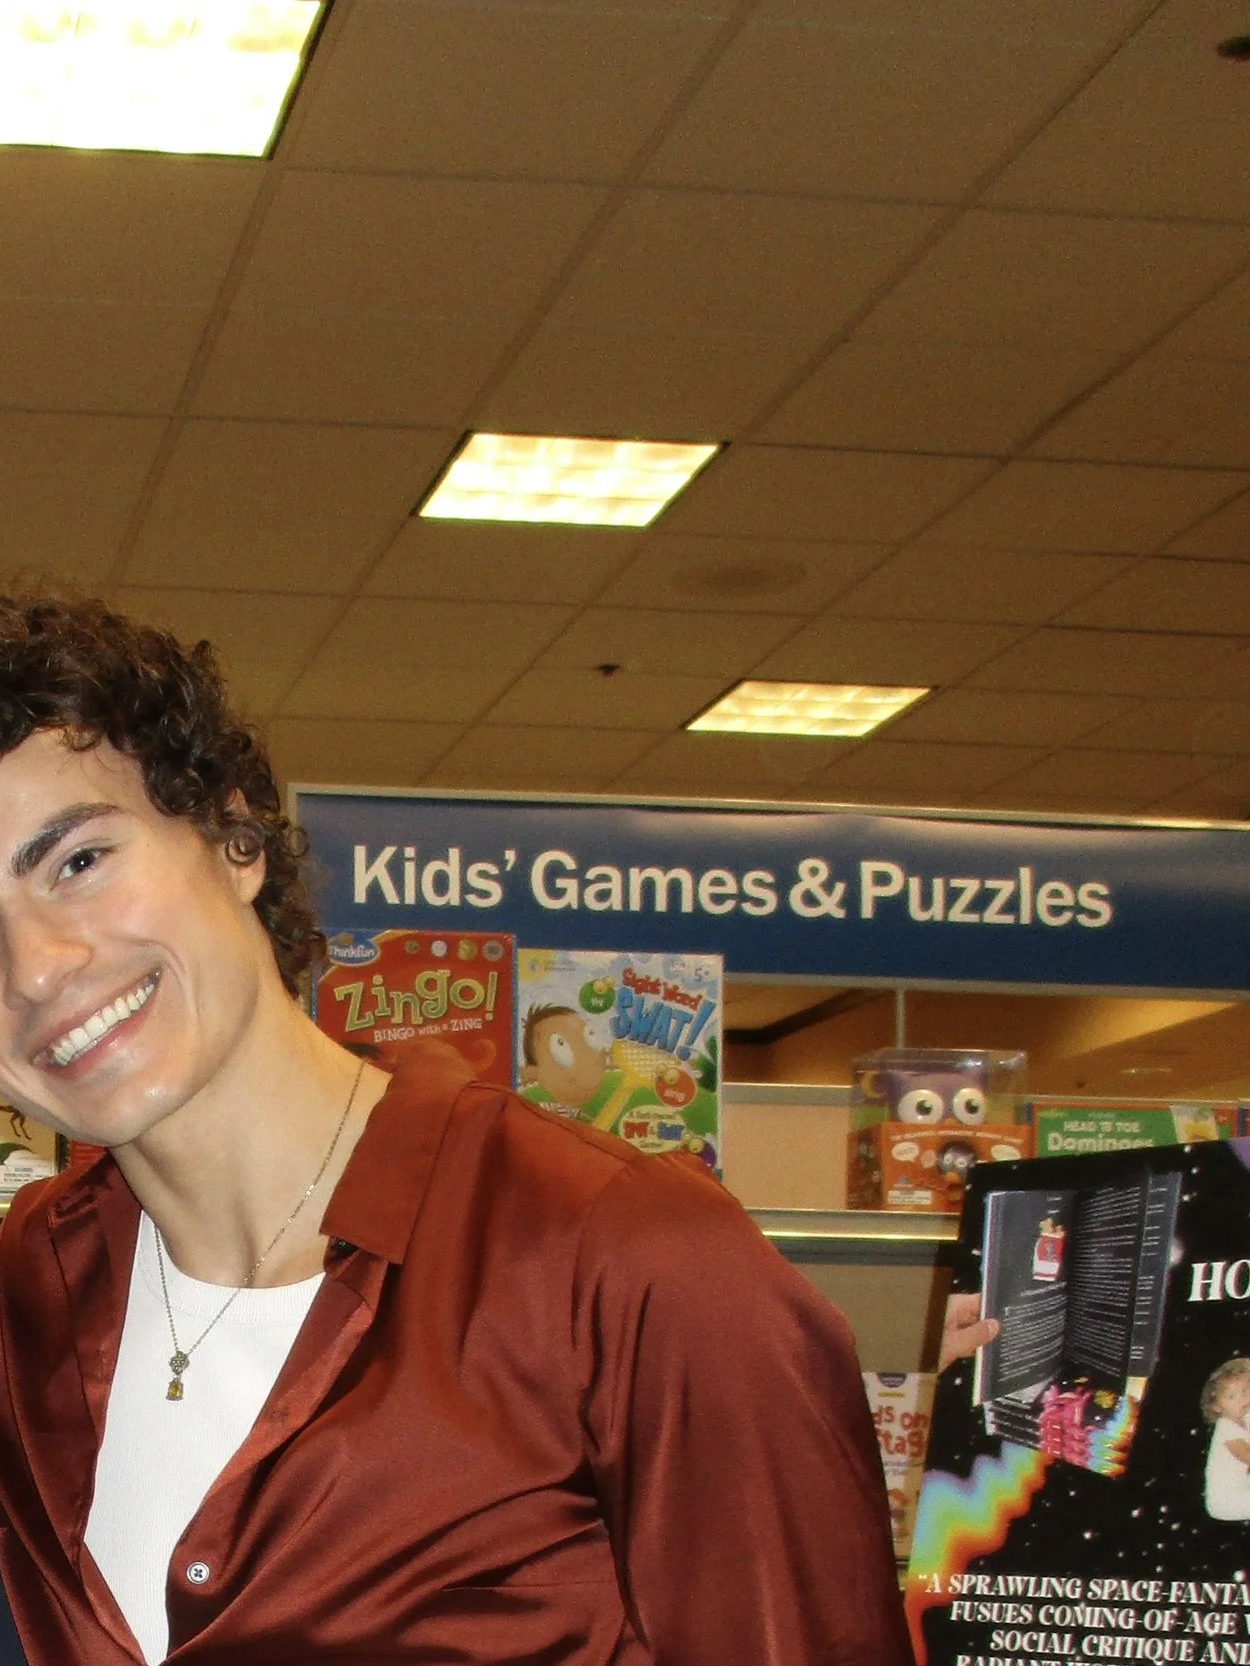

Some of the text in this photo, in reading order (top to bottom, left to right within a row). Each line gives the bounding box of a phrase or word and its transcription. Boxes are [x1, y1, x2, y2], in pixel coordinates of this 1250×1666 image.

[352, 845, 1114, 929] Kids' Games & Puzzles
[334, 969, 499, 1033] Zingo!
[373, 1027, 415, 1043] BINGO
[418, 1025, 442, 1037] with
[451, 1018, 483, 1032] ZING
[612, 986, 717, 1061] SWAT!
[947, 1573, 1083, 1598] SPRAWLING
[950, 1600, 1237, 1637] FUSUES COMING-OF-AGE
[989, 1629, 1077, 1655] SOCIAL
[1081, 1634, 1196, 1666] CRITIQUE
